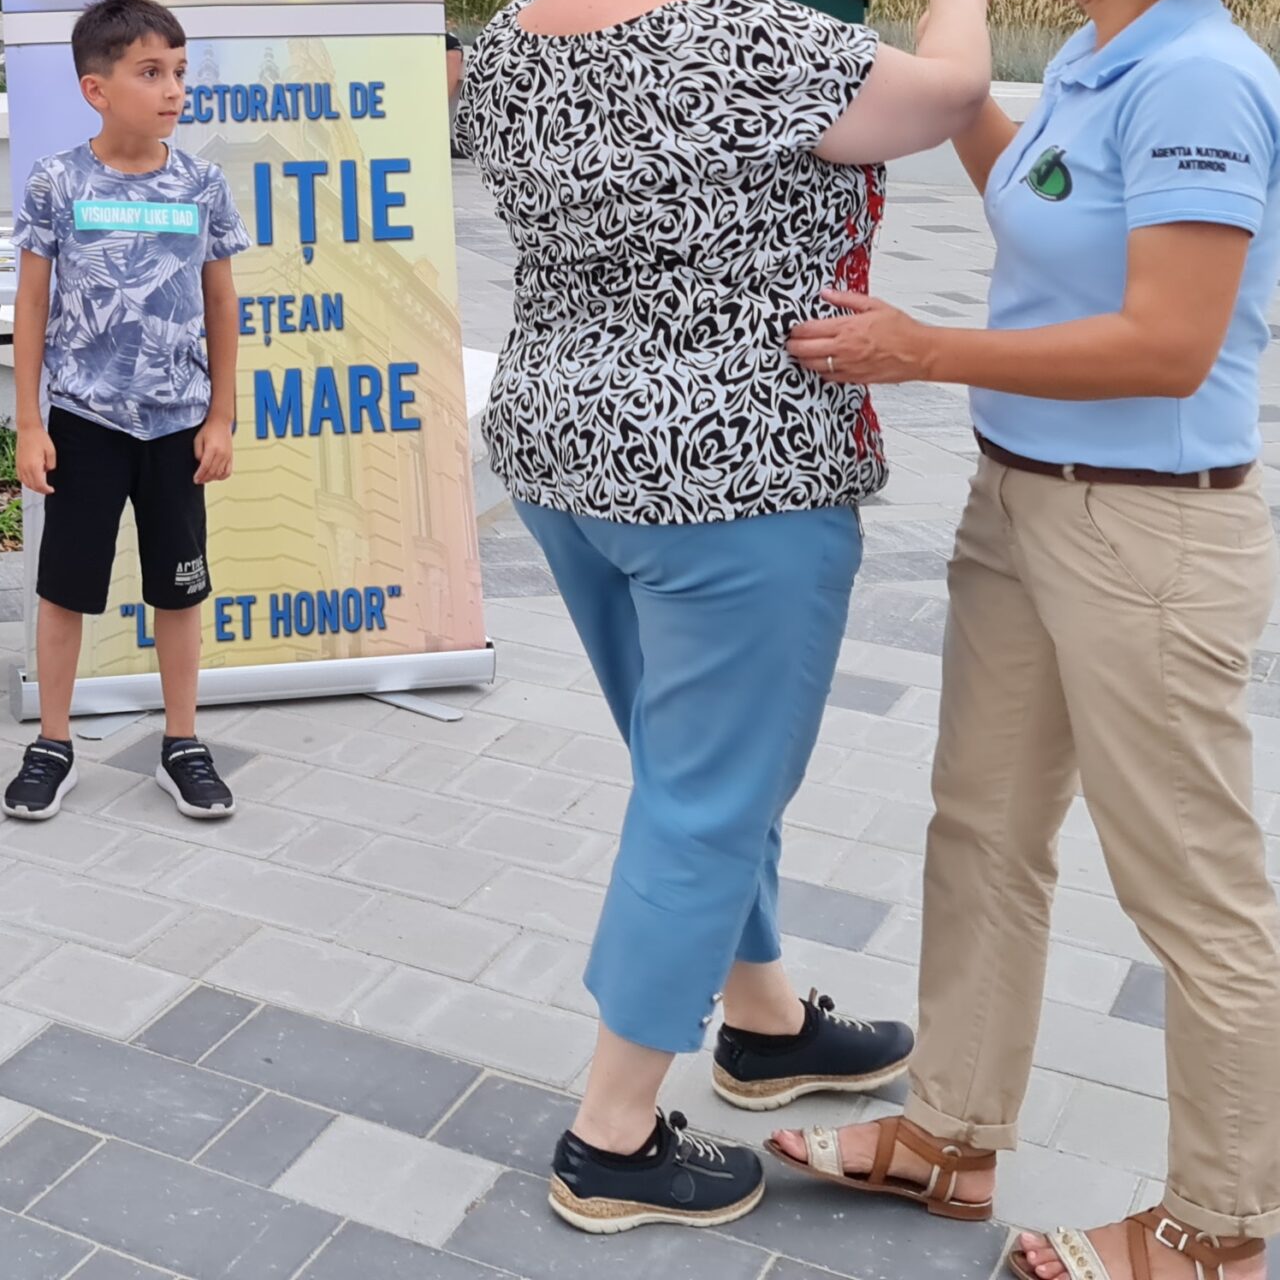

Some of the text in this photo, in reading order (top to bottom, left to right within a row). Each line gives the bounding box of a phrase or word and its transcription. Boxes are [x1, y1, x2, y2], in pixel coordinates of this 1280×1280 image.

[178, 81, 386, 124] ECTORATUL DE
[81, 206, 193, 227] VISIONARY LIKE DAD
[254, 158, 414, 264] IȚIE
[239, 292, 345, 348] EȚEAN
[254, 362, 422, 440] MARE
[214, 595, 257, 642] ET
[269, 585, 403, 639] HONOR"
